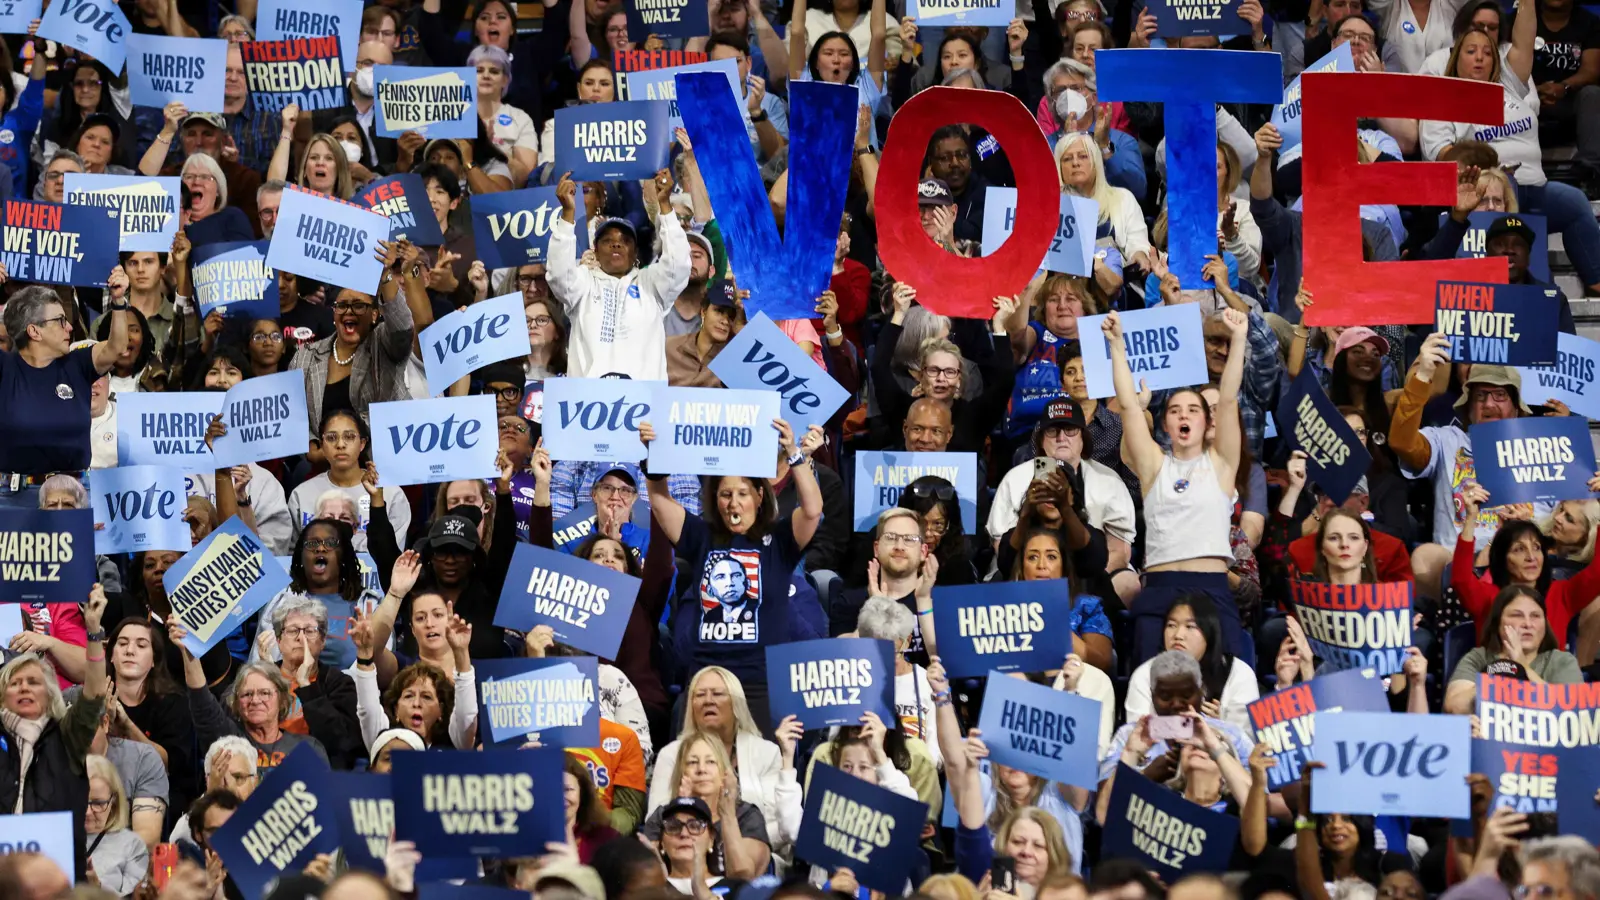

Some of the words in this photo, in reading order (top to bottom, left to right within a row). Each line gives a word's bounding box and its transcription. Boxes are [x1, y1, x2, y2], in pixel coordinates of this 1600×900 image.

[275, 8, 340, 36] HARRIS
[641, 8, 681, 24] WALZ
[1176, 6, 1221, 20] WALZ
[243, 36, 337, 60] FREEDOM
[143, 53, 204, 79] HARRIS
[248, 58, 341, 91] FREEDOM
[151, 78, 194, 94] WALZ
[376, 82, 472, 103] PENNSYLVANIA
[656, 82, 675, 100] NE
[385, 103, 421, 121] VOTES
[425, 102, 465, 120] EARLY
[574, 120, 646, 148] HARRIS
[1475, 117, 1532, 143] OBVIOUSLY
[585, 148, 636, 162] WALZ
[68, 191, 175, 213] PENNSYLVANIA
[364, 181, 404, 206] YES
[371, 197, 407, 215] SHE
[7, 201, 62, 230] WHEN
[123, 215, 166, 232] EARLY
[4, 226, 31, 253] WE
[36, 230, 84, 262] VOTE,
[296, 214, 367, 254] HARRIS
[4, 253, 30, 279] WE
[35, 257, 72, 282] WIN
[303, 243, 352, 268] WALZ
[193, 260, 274, 281] PENNSYLVANIA
[198, 285, 220, 303] VOTES
[223, 281, 267, 300] EARLY
[1440, 285, 1494, 311] WHEN
[433, 313, 510, 365] vote
[1438, 309, 1466, 334] WE
[1469, 313, 1520, 343] VOTE,
[1470, 338, 1509, 363] WIN
[743, 339, 820, 415] vote
[1538, 372, 1583, 396] WALZ
[229, 393, 290, 426] HARRIS
[559, 396, 650, 431] vote
[669, 403, 680, 423] A
[684, 404, 721, 424] NEW
[726, 405, 760, 426] WAY
[141, 413, 215, 437] HARRIS
[240, 423, 281, 443] WALZ
[388, 414, 481, 455] vote
[675, 425, 752, 448] FORWARD
[1296, 393, 1350, 466] HARRIS
[153, 440, 206, 455] WALZ
[1293, 420, 1330, 469] WALZ
[1496, 435, 1574, 467] HARRIS
[874, 465, 885, 485] A
[888, 466, 923, 485] NEW
[1512, 465, 1565, 482] WALZ
[104, 481, 175, 521] vote
[0, 531, 73, 563] HARRIS
[2, 563, 60, 582] WALZ
[169, 533, 260, 613] ENNSYLVANIA
[181, 590, 228, 631] VOTES
[219, 557, 266, 602] EARLY
[528, 567, 610, 617] HARRIS
[1292, 582, 1408, 610] FREEDOM
[534, 598, 592, 628] WALZ
[958, 602, 1045, 637] HARRIS
[701, 622, 755, 640] HOPE
[1296, 607, 1411, 649] FREEDOM
[972, 634, 1033, 655] WALZ
[790, 659, 872, 692] HARRIS
[481, 677, 594, 704] PENNSYLVANIA
[803, 687, 861, 708] WALZ
[490, 705, 531, 728] VOTES
[536, 700, 585, 726] EARLY
[1250, 684, 1316, 729] WHEN
[1001, 700, 1076, 745] HARRIS
[1479, 701, 1600, 748] FREEDOM
[1011, 735, 1063, 760] WALZ
[1258, 722, 1294, 755] WE
[1271, 750, 1301, 786] WE
[1335, 734, 1449, 778] vote
[1502, 751, 1558, 775] YES
[423, 773, 534, 812] HARRIS
[1499, 776, 1556, 798] SHE
[241, 781, 317, 865] HARRIS
[440, 812, 518, 834] WALZ
[819, 790, 895, 848] HARRIS
[1126, 794, 1206, 856] HARRIS
[269, 815, 322, 871] WALZ
[824, 825, 873, 864] WALZ
[1132, 827, 1186, 870] WALZ
